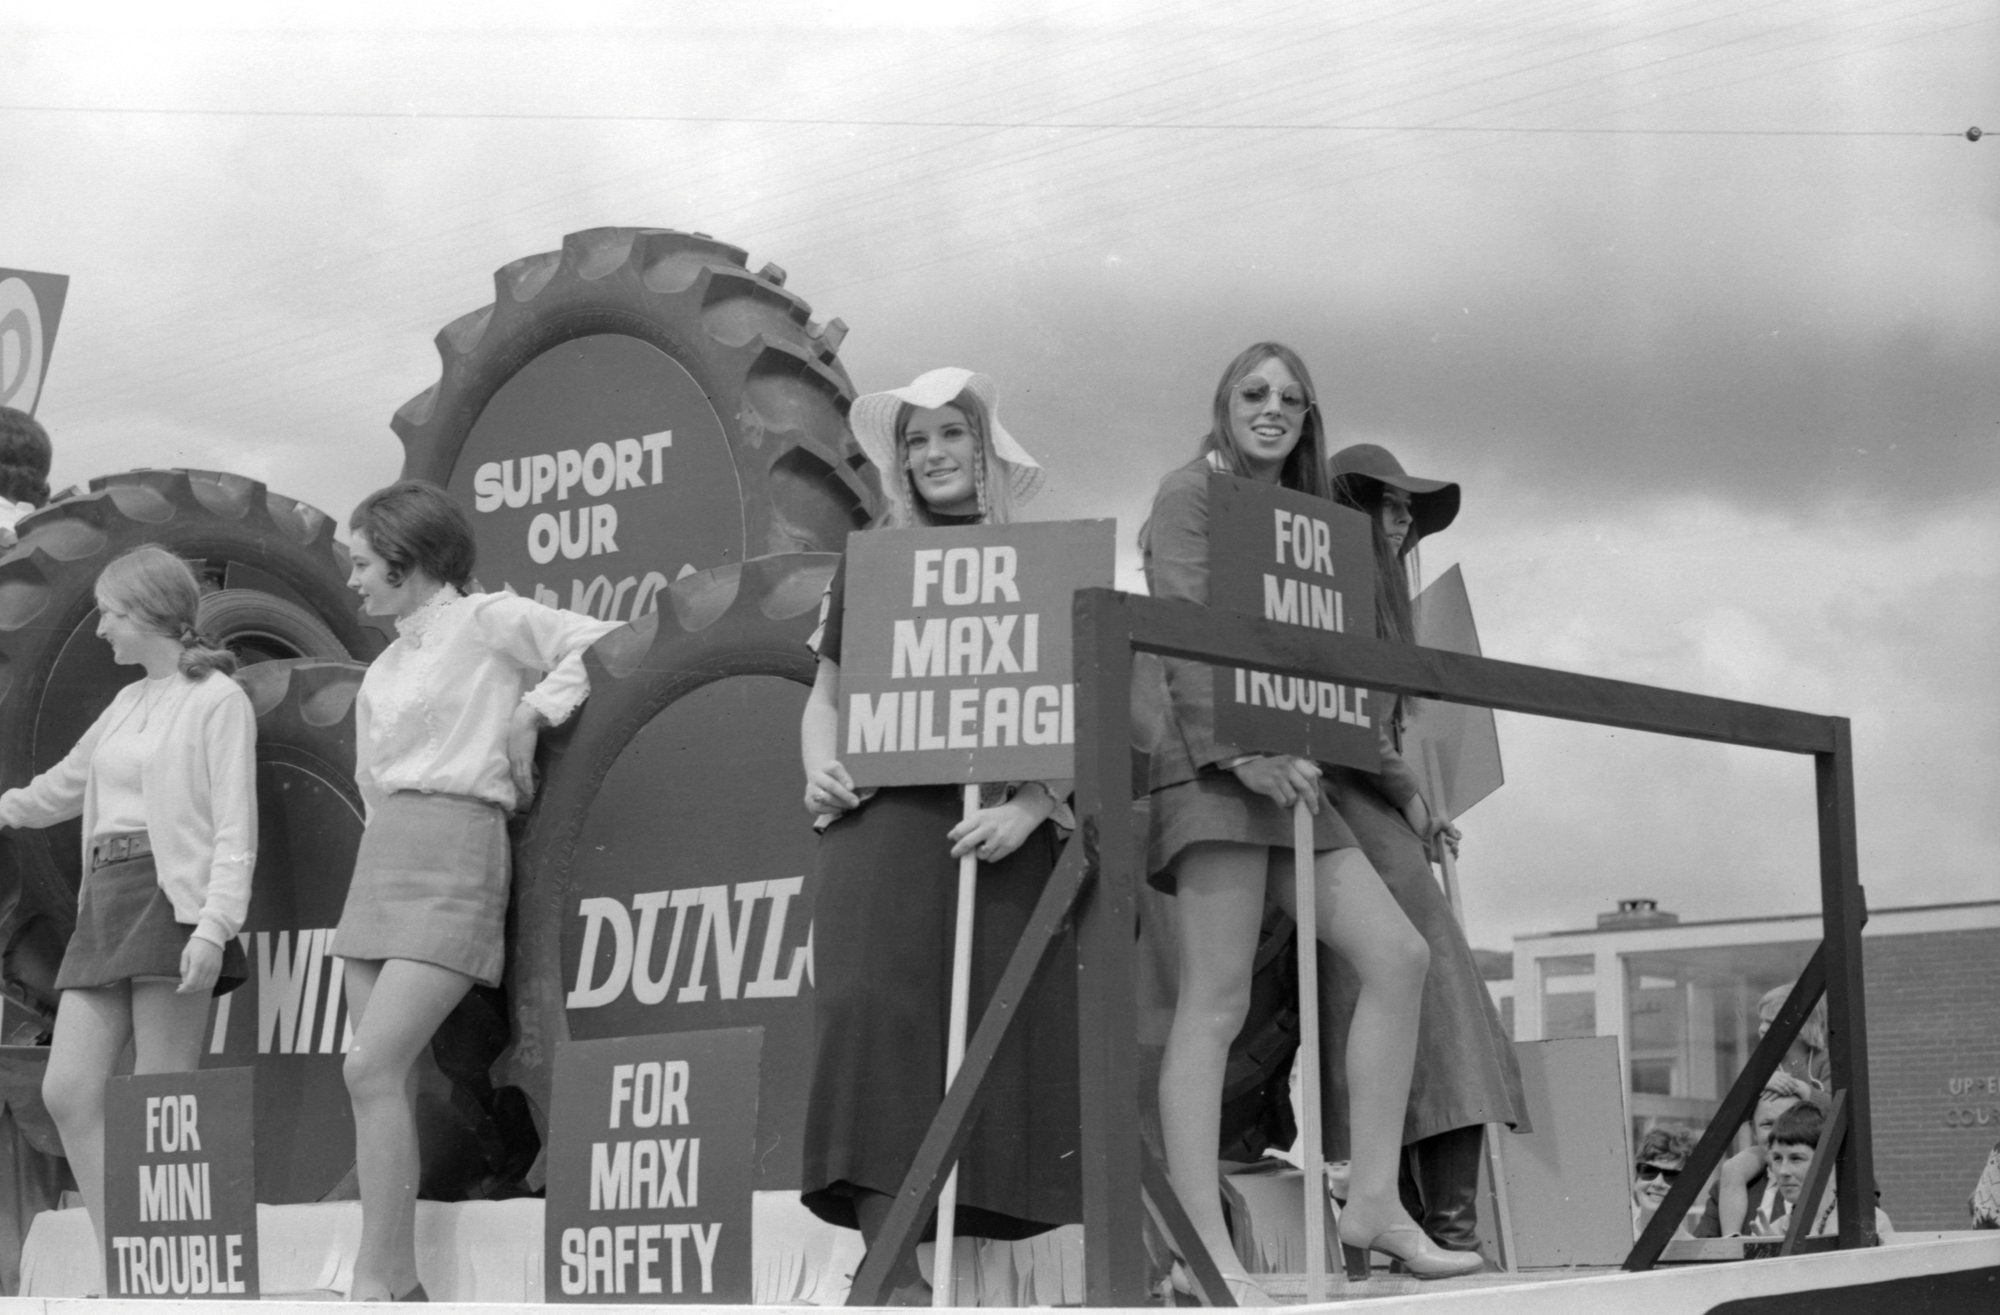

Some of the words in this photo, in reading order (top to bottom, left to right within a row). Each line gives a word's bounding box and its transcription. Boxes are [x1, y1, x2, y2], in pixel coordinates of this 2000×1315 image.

[474, 430, 673, 513] SUPPORT
[527, 503, 620, 565] OUR
[1274, 508, 1335, 577] FOR
[912, 545, 1021, 607] FOR
[1263, 573, 1345, 633] MINI
[891, 613, 1040, 679] MAXI
[565, 875, 815, 1009] DUNL
[146, 1095, 201, 1153] FOR
[609, 1060, 690, 1129] FOR
[138, 1162, 212, 1222] MINI
[589, 1138, 701, 1210] MAXI
[112, 1234, 246, 1295] TROUBLE
[560, 1223, 723, 1296] SAFETY
